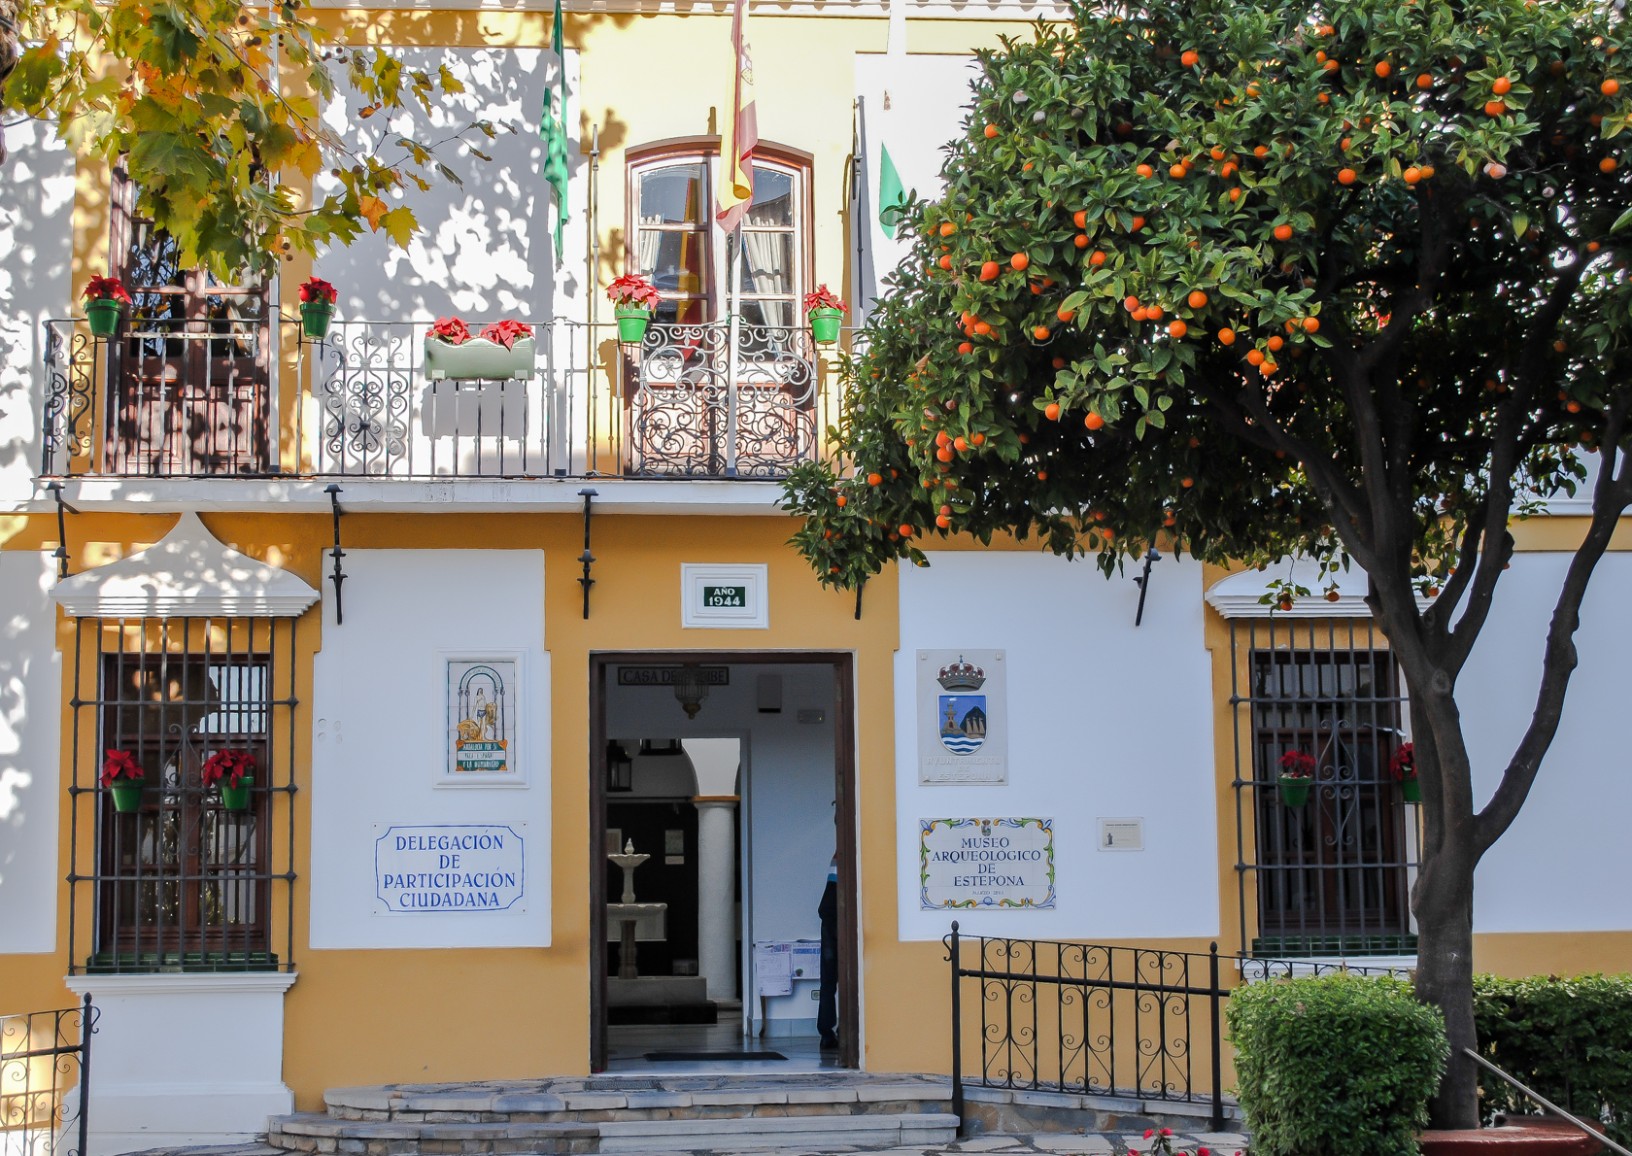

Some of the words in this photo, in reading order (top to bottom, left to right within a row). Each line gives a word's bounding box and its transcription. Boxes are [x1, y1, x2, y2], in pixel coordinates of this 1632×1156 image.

[713, 586, 736, 596] AÑO
[709, 596, 740, 606] 1944
[623, 670, 659, 682] CASA
[395, 829, 504, 851] DELEGACIÓN
[961, 837, 1010, 848] MUSEO
[439, 854, 461, 869] DE
[978, 863, 996, 874] DE
[383, 866, 516, 889] PARTICIPACIÓN
[954, 875, 1025, 887] ESTEPONA
[399, 892, 500, 908] CIUDADANA
